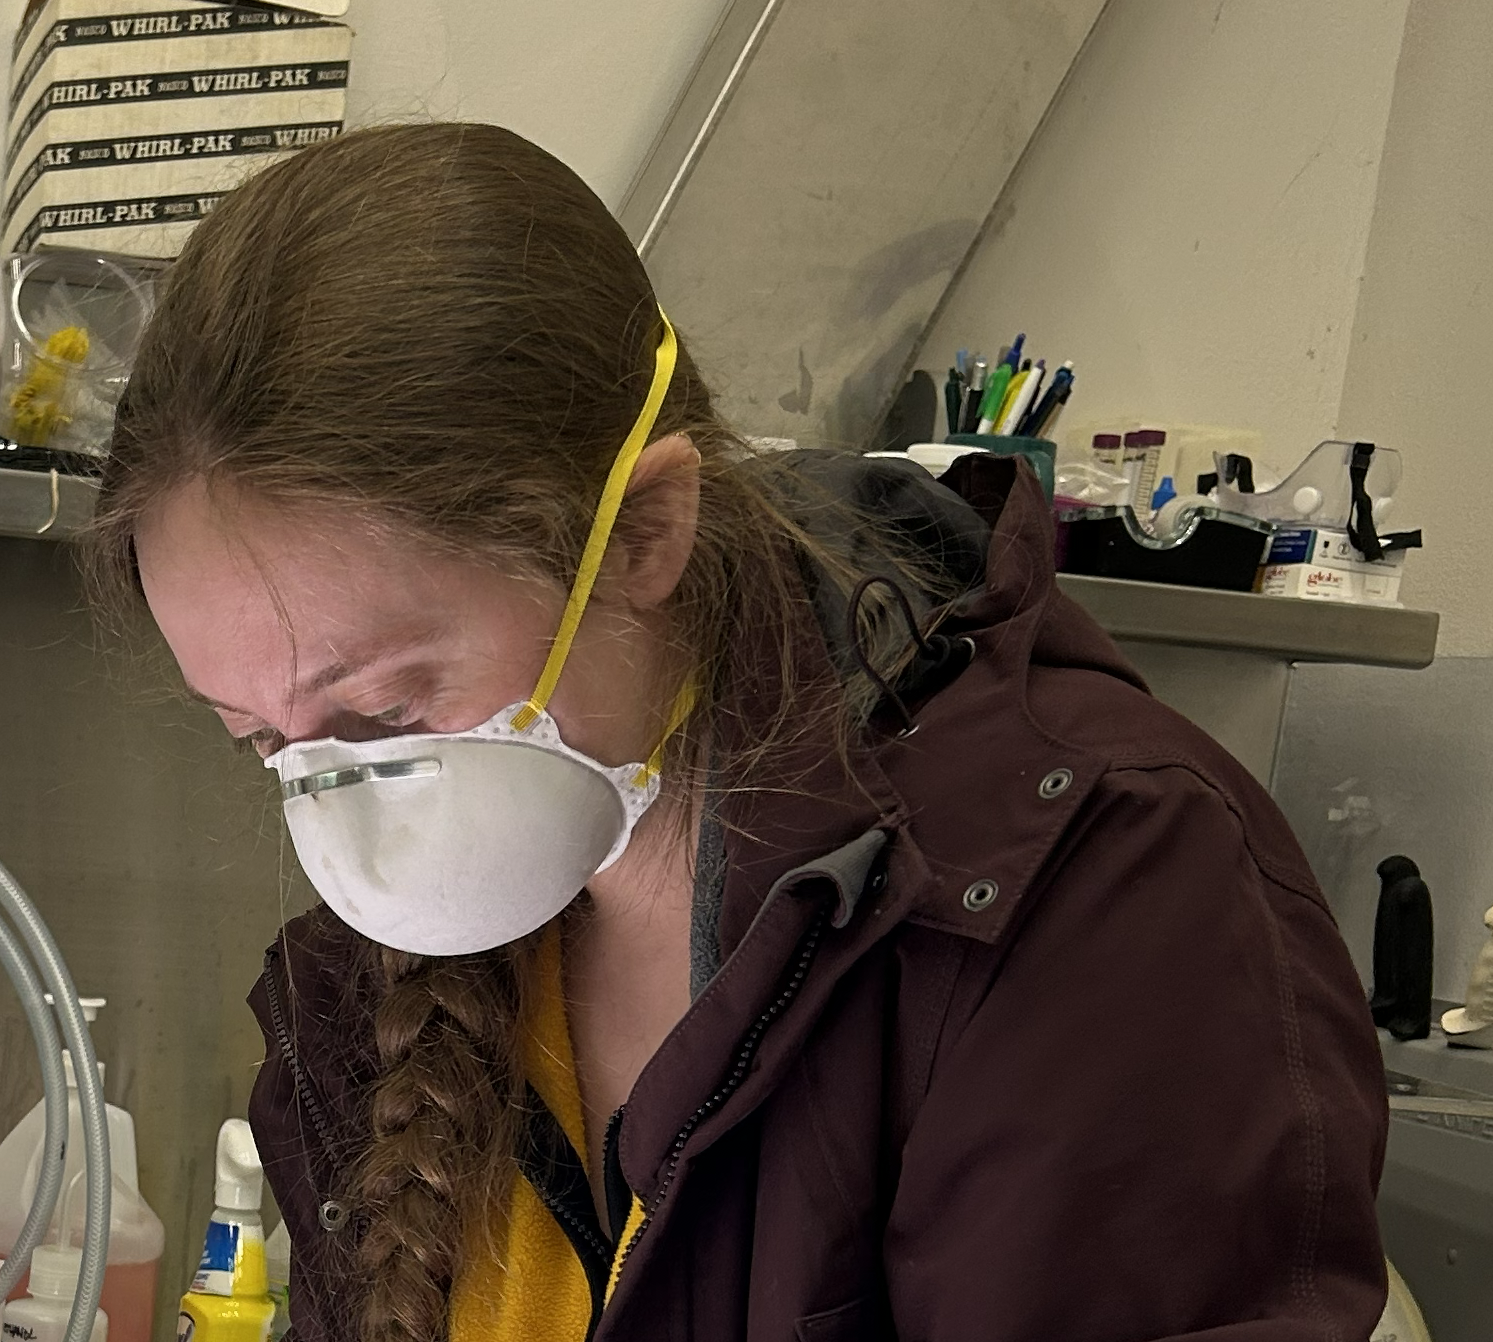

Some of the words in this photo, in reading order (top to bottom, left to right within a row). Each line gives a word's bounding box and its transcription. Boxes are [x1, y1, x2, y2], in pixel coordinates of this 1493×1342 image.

[110, 11, 233, 37] WHIRL-PAK
[191, 69, 311, 93] WHIRL-PAK
[113, 134, 235, 159] WHIRL-PAK
[39, 202, 158, 228] WHIRL-PAK
